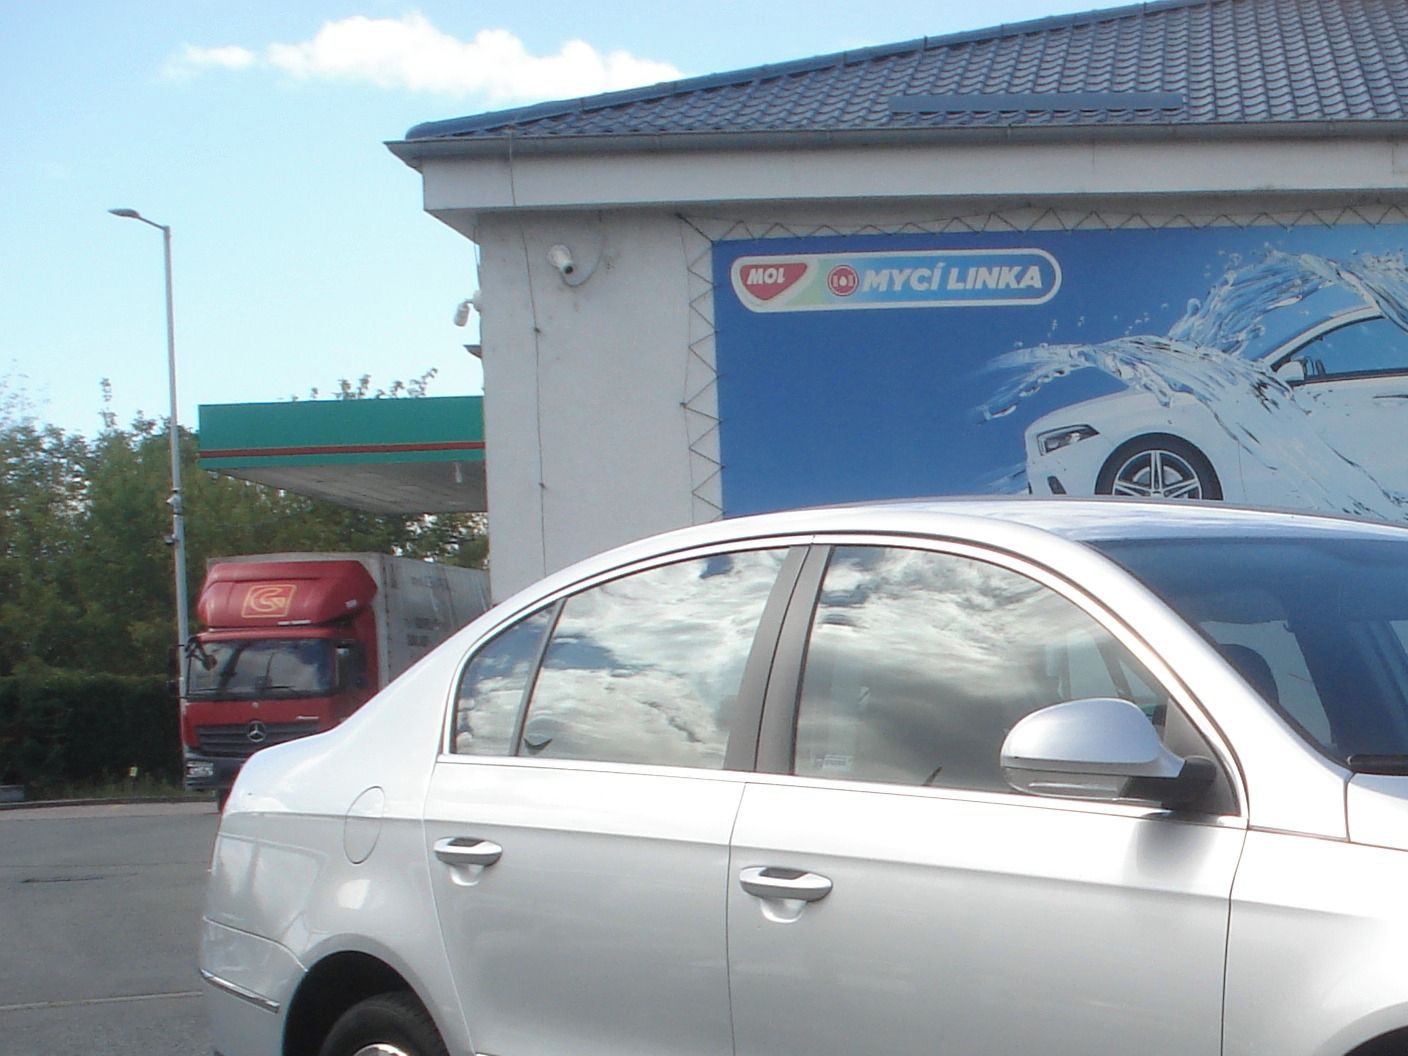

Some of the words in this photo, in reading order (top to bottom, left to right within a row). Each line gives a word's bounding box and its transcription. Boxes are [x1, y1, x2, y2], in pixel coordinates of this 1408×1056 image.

[746, 267, 785, 285] MOL
[862, 262, 945, 293] MYCÍ
[948, 265, 1043, 291] LINKA
